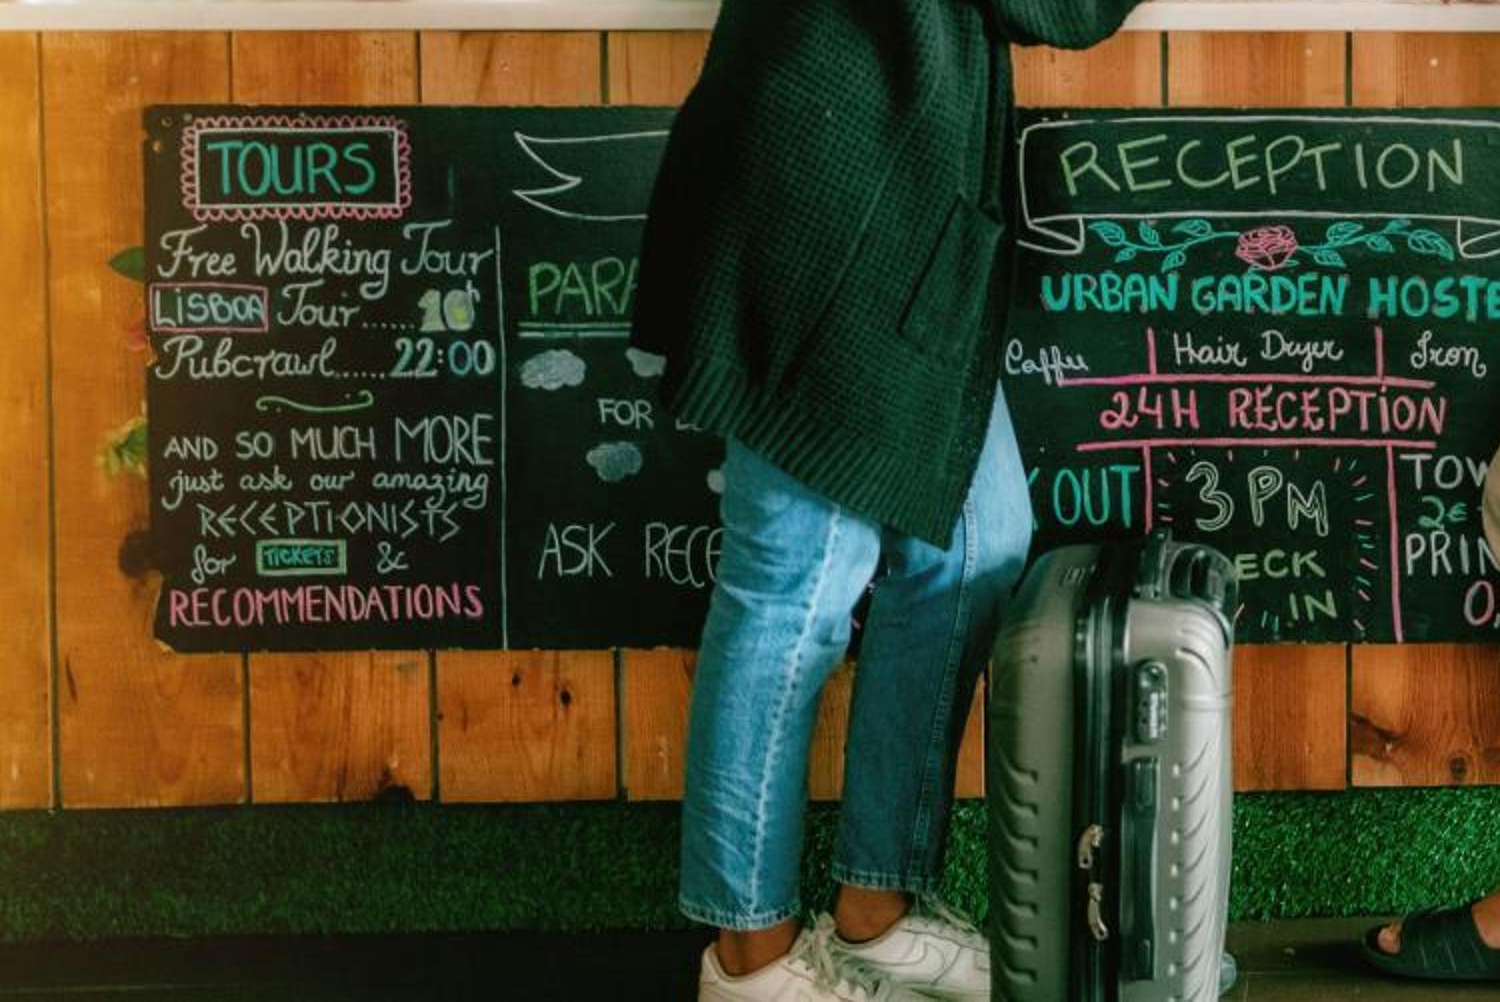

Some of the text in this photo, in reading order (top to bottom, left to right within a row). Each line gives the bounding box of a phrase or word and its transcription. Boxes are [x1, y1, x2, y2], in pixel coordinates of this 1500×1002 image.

[207, 140, 377, 196] TOURS
[1059, 134, 1466, 196] RECEPTION
[157, 219, 494, 300] Free Walking Tour
[277, 279, 360, 327] Tour
[1041, 273, 1180, 314] URBAN
[1191, 273, 1348, 317] GARDEN
[390, 337, 496, 377] 22:00
[1173, 331, 1247, 367] Hair
[1261, 329, 1344, 373] Dryer
[1410, 330, 1487, 378] Iron
[597, 398, 655, 430] FOR
[1100, 386, 1201, 430] 24H
[164, 413, 494, 466] AND SO MUCH MORE
[162, 465, 489, 510] just ask our amazing
[1400, 453, 1489, 491] TOW
[1053, 464, 1142, 529] OUT
[1185, 460, 1330, 539] 3 PM
[197, 499, 461, 543] RECEPTIONISTS
[191, 544, 237, 585] for
[377, 541, 409, 574] &
[537, 521, 616, 581] ASK
[1235, 548, 1327, 580] ECK
[169, 582, 484, 628] RECOMMENDATIONS
[1288, 589, 1338, 622] IN
